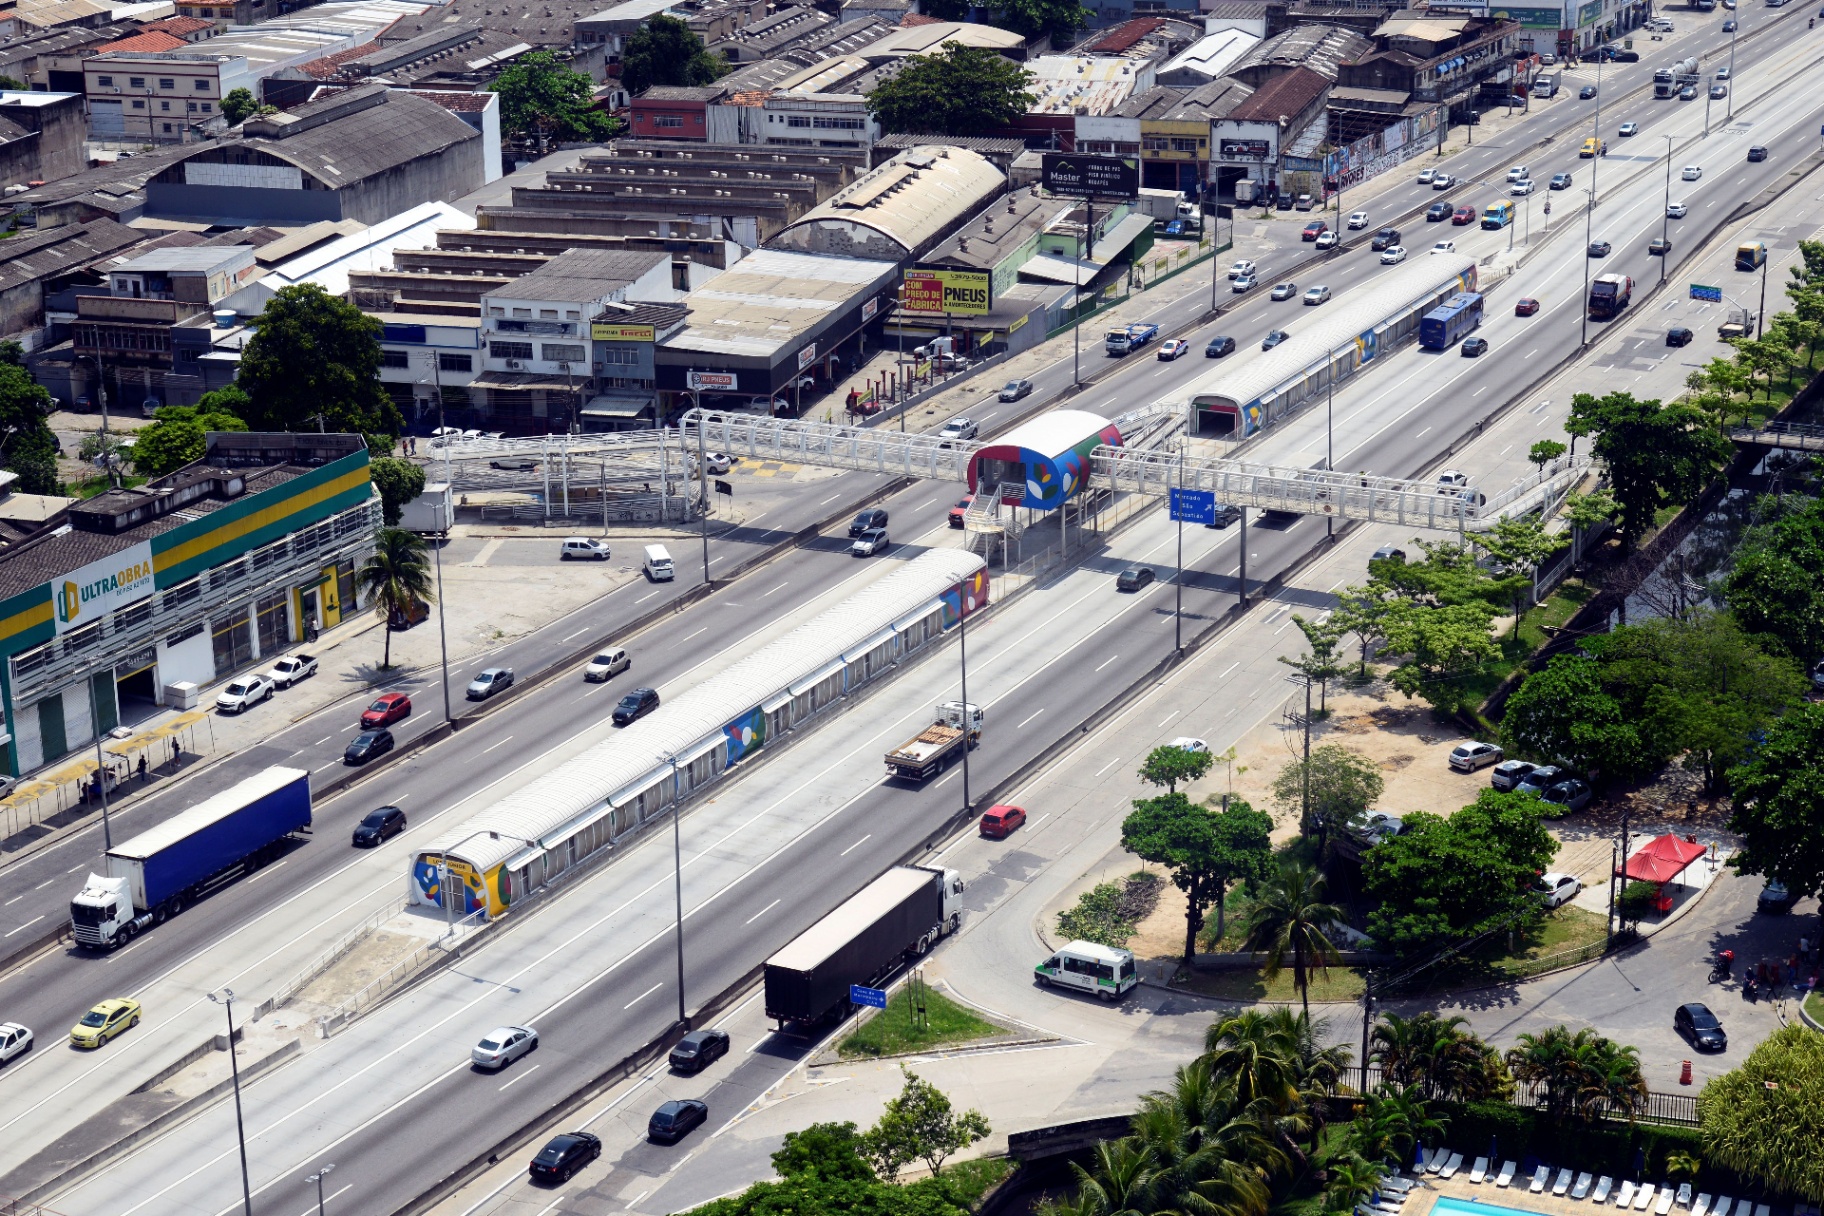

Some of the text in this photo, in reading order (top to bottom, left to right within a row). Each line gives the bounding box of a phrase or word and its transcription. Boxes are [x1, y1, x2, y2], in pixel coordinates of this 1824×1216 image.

[1050, 172, 1080, 182] Master
[906, 281, 922, 289] COM
[906, 290, 929, 299] PREÇO
[944, 287, 986, 302] PNEUS
[906, 298, 941, 310] FÁBRICA
[81, 561, 150, 602] ULTRAOBRA
